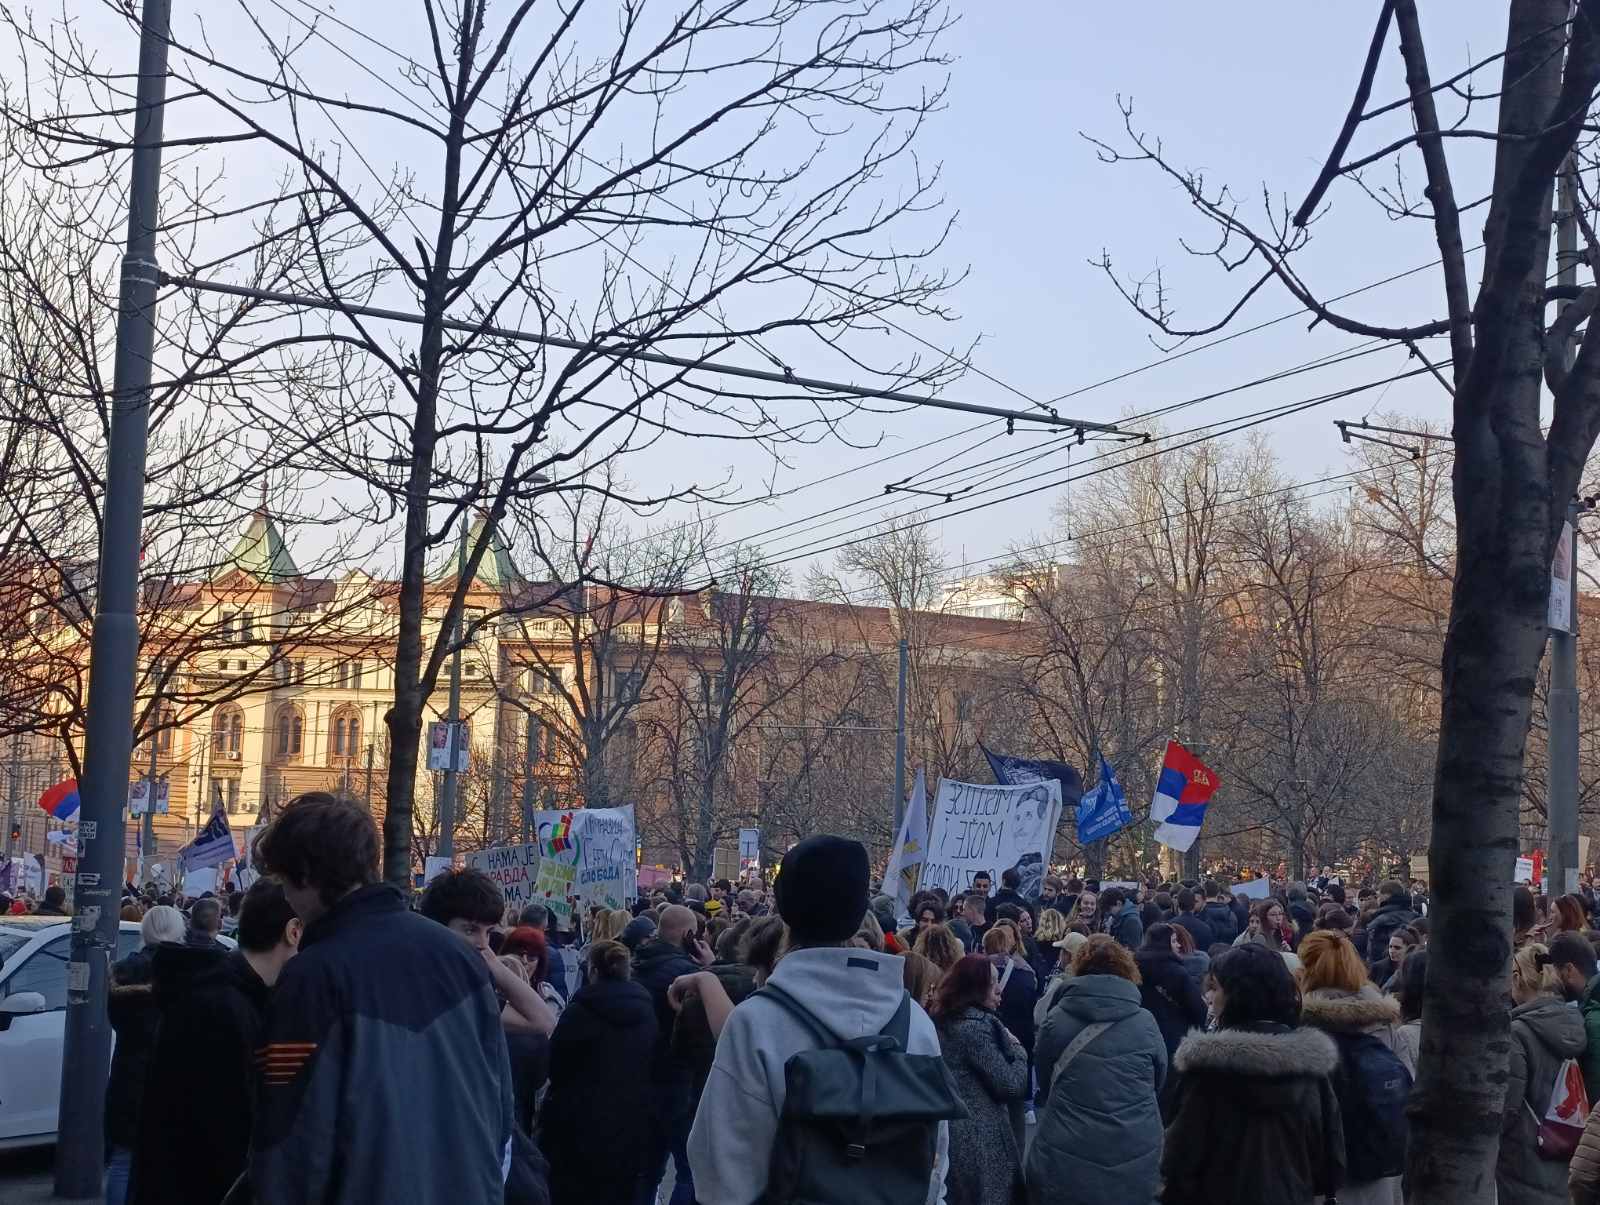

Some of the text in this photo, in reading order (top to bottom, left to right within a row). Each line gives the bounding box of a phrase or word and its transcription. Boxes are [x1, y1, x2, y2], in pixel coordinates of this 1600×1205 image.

[488, 848, 519, 870] НАМА
[488, 866, 529, 885] РАВДА
[581, 865, 620, 885] СЛОБОДА
